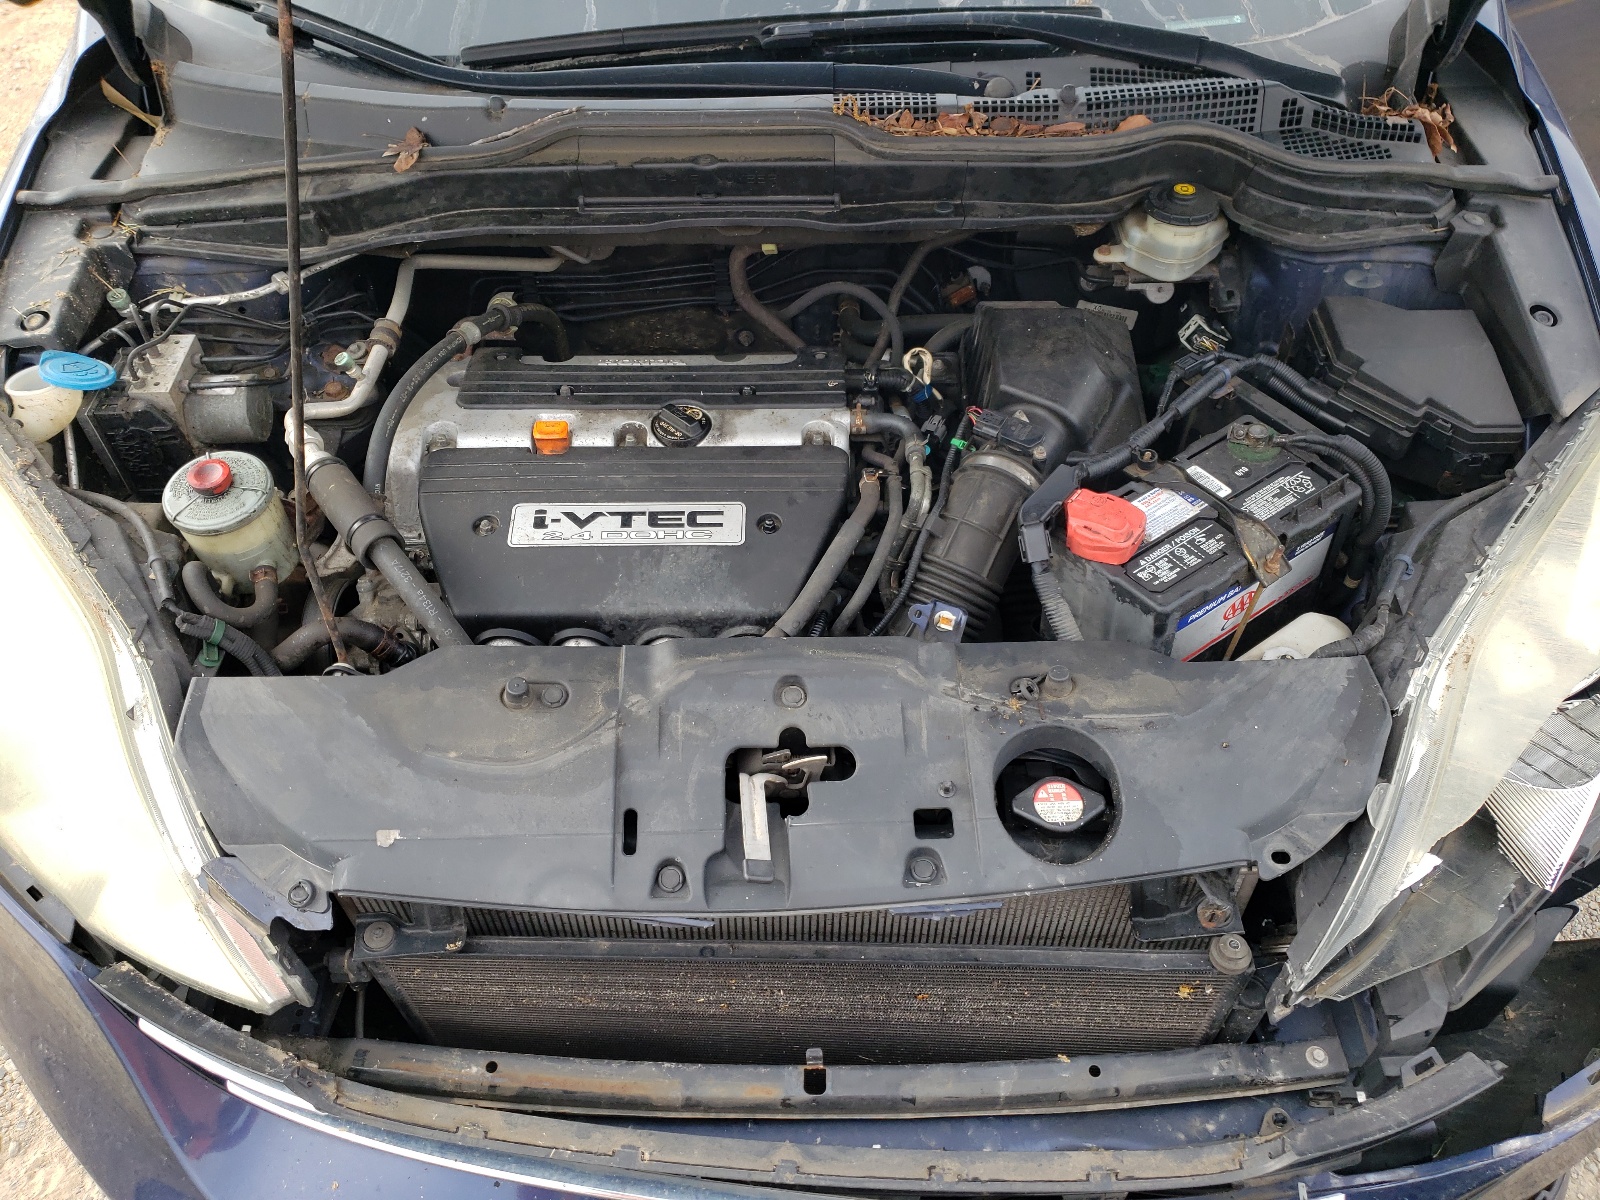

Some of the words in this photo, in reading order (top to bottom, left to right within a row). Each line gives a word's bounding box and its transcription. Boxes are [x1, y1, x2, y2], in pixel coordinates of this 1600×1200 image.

[533, 509, 724, 530] i-VTEC
[542, 530, 593, 540] 2.4
[600, 530, 713, 540] DOHC
[1144, 544, 1172, 561] DANGER
[1175, 527, 1201, 544] POISON
[416, 589, 438, 617] R134a
[1188, 593, 1227, 623] PREMIUM
[1226, 586, 1242, 598] BA
